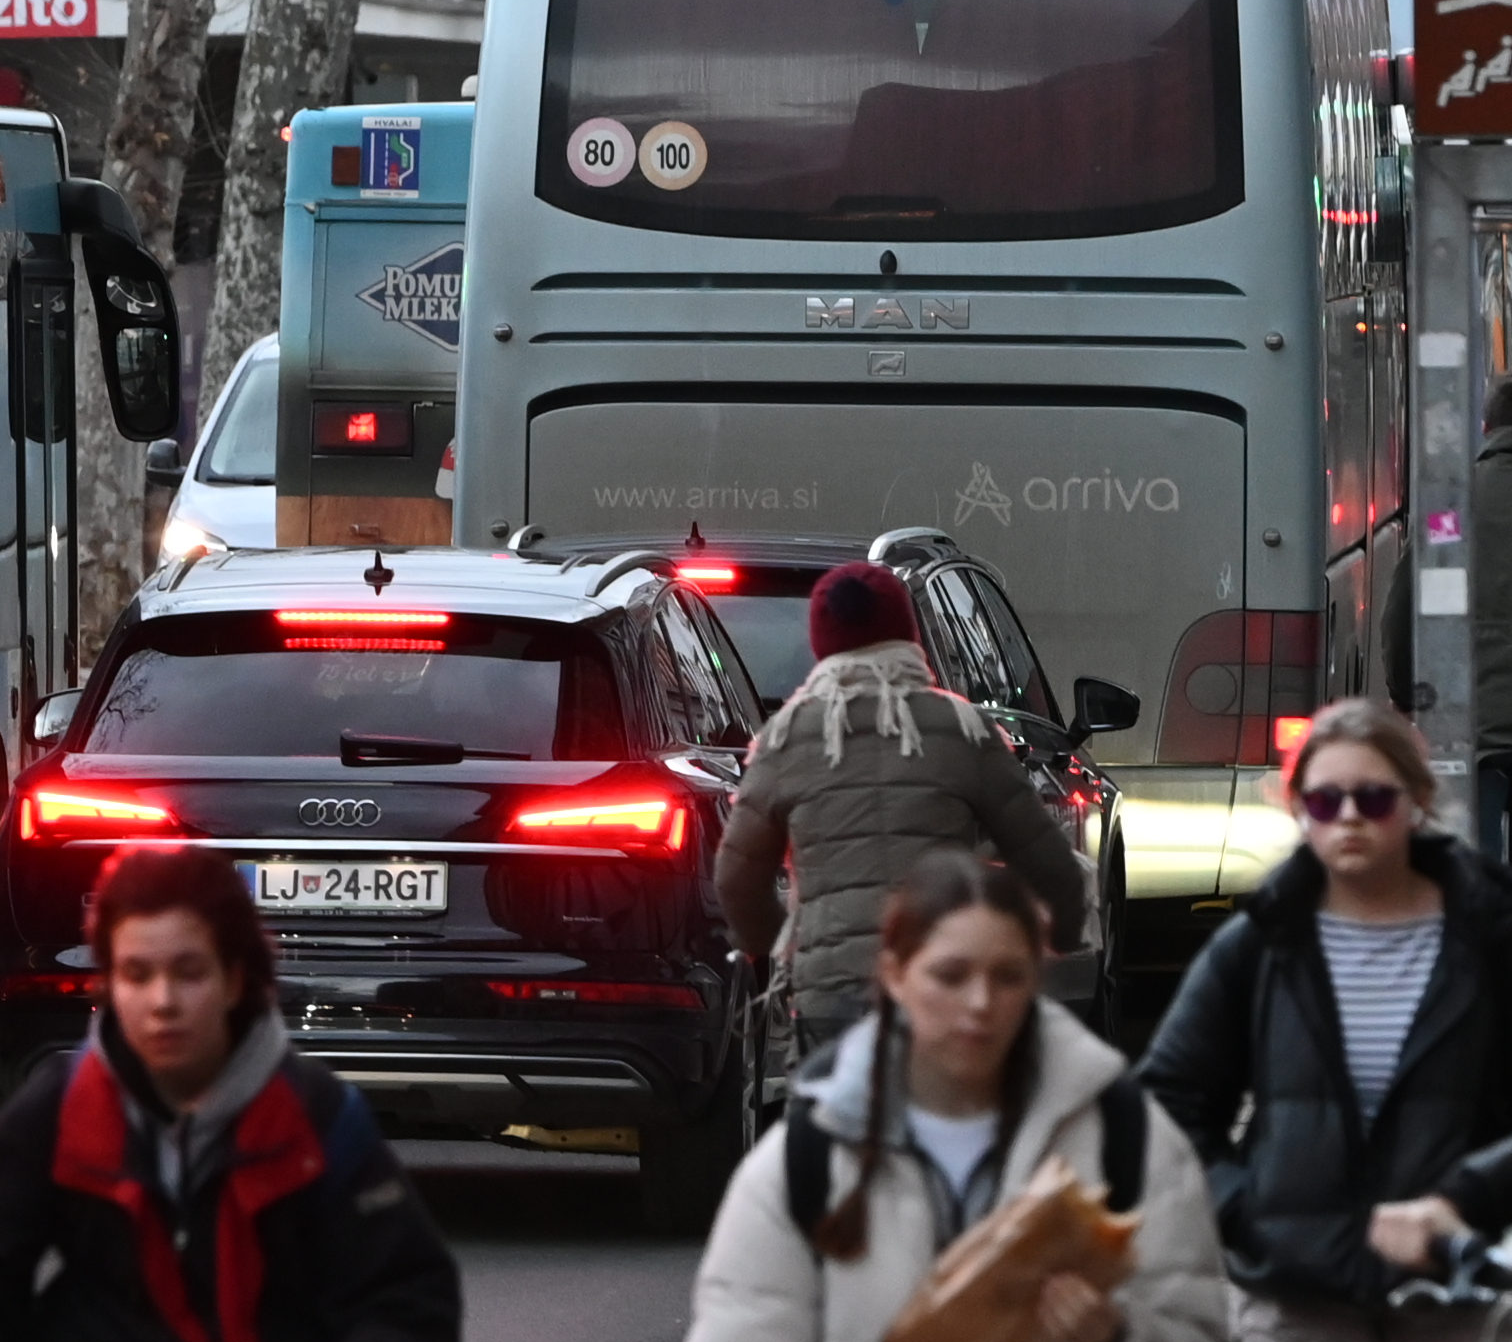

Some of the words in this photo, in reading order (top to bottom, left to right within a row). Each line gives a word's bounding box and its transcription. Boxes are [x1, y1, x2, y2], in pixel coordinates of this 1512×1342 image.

[584, 139, 615, 166] 80
[656, 143, 690, 169] 100
[384, 266, 461, 296] POMU
[384, 296, 461, 321] MLEK
[805, 297, 970, 330] MAN
[593, 480, 819, 510] www.arriva.si
[1022, 467, 1180, 511] arriva
[260, 869, 300, 901] LJ
[324, 868, 440, 901] 24-RGT
